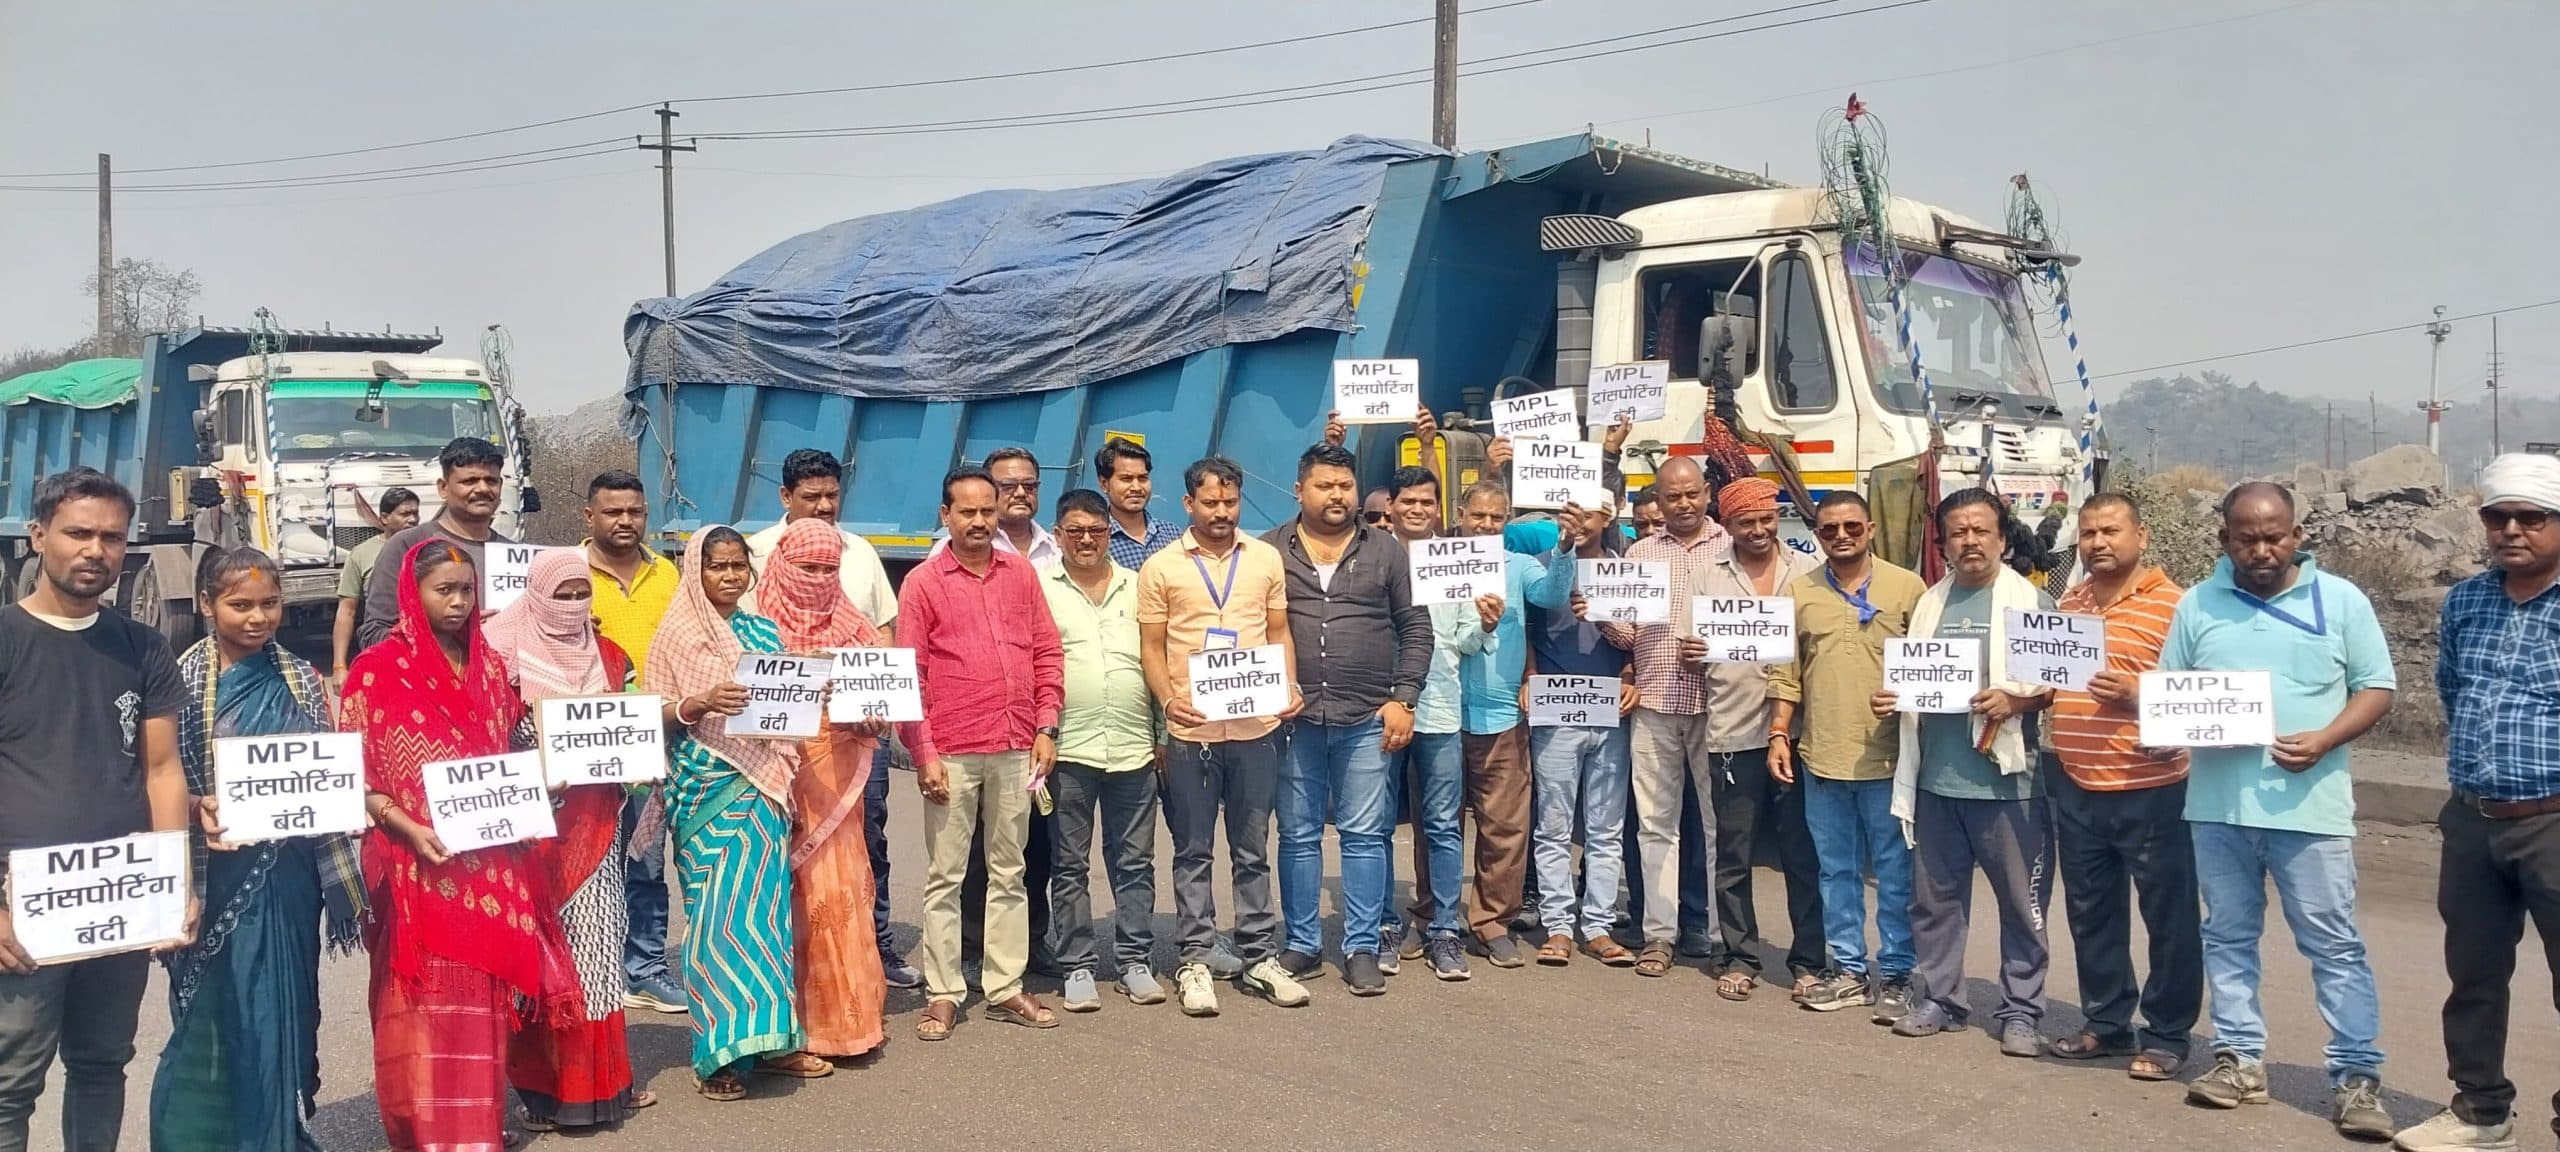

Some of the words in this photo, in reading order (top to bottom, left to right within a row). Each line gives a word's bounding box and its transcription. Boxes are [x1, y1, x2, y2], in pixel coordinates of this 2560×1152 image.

[1352, 364, 1402, 376] MPL
[1604, 366, 1652, 382] MPL
[1340, 381, 1414, 397] ट्रांसपोर्टिंग
[1592, 384, 1662, 405] ट्रांसपोर्टिंग
[1365, 401, 1390, 415] बंदी
[1508, 395, 1558, 413] MPL
[1499, 412, 1571, 434] ट्रांसपोर्टिंग
[1531, 444, 1585, 459] MPL
[1518, 464, 1596, 480] ट्रांसपोर्टिंग
[1544, 488, 1571, 502] बंदी
[1429, 539, 1485, 556] MPL
[1417, 559, 1498, 580] ट्रांसपोर्टिंग
[1597, 562, 1652, 578] MPL
[1446, 583, 1472, 598] बंदी
[1712, 600, 1774, 614] MPL
[1697, 620, 1788, 638] ट्रांसपोर्टिंग
[2024, 613, 2083, 634] MPL
[1728, 645, 1757, 662] बंदी
[1903, 643, 1959, 657] MPL
[2010, 637, 2099, 660] ट्रांसपोर्टिंग
[755, 659, 811, 677] MPL
[841, 652, 898, 667] MPL
[1207, 649, 1266, 669] MPL
[1196, 671, 1280, 695] ट्रांसपोर्टिंग
[1890, 665, 1973, 683] ट्रांसपोर्टिंग
[2040, 667, 2069, 684] बंदी
[832, 673, 912, 694] ट्रांसपोर्टिंग
[1548, 678, 1603, 689] MPL
[2166, 677, 2244, 691] MPL
[1227, 697, 1254, 714] बंदी
[1533, 692, 1616, 706] ट्रांसपोर्टिंग
[1916, 692, 1943, 708] बंदी
[2147, 697, 2263, 718] ट्रांसपोर्टिंग
[567, 701, 638, 720] MPL
[861, 700, 889, 717] बंदी
[1560, 711, 1587, 723] बंदी
[760, 712, 788, 730] बंदी
[550, 726, 656, 752] ट्रांसपोर्टिंग
[2185, 724, 2224, 741] बंदी
[248, 741, 334, 764] MPL
[447, 761, 519, 784] MPL
[588, 757, 622, 777] बंदी
[227, 769, 355, 801] ट्रांसपोर्टिंग
[436, 785, 540, 816] ट्रांसपोर्टिंग
[272, 806, 315, 829] बंदी
[478, 819, 513, 839] बंदी
[49, 843, 152, 874] MPL
[22, 873, 176, 917] ट्रांसपोर्टिंग
[75, 916, 127, 944] बंदी
